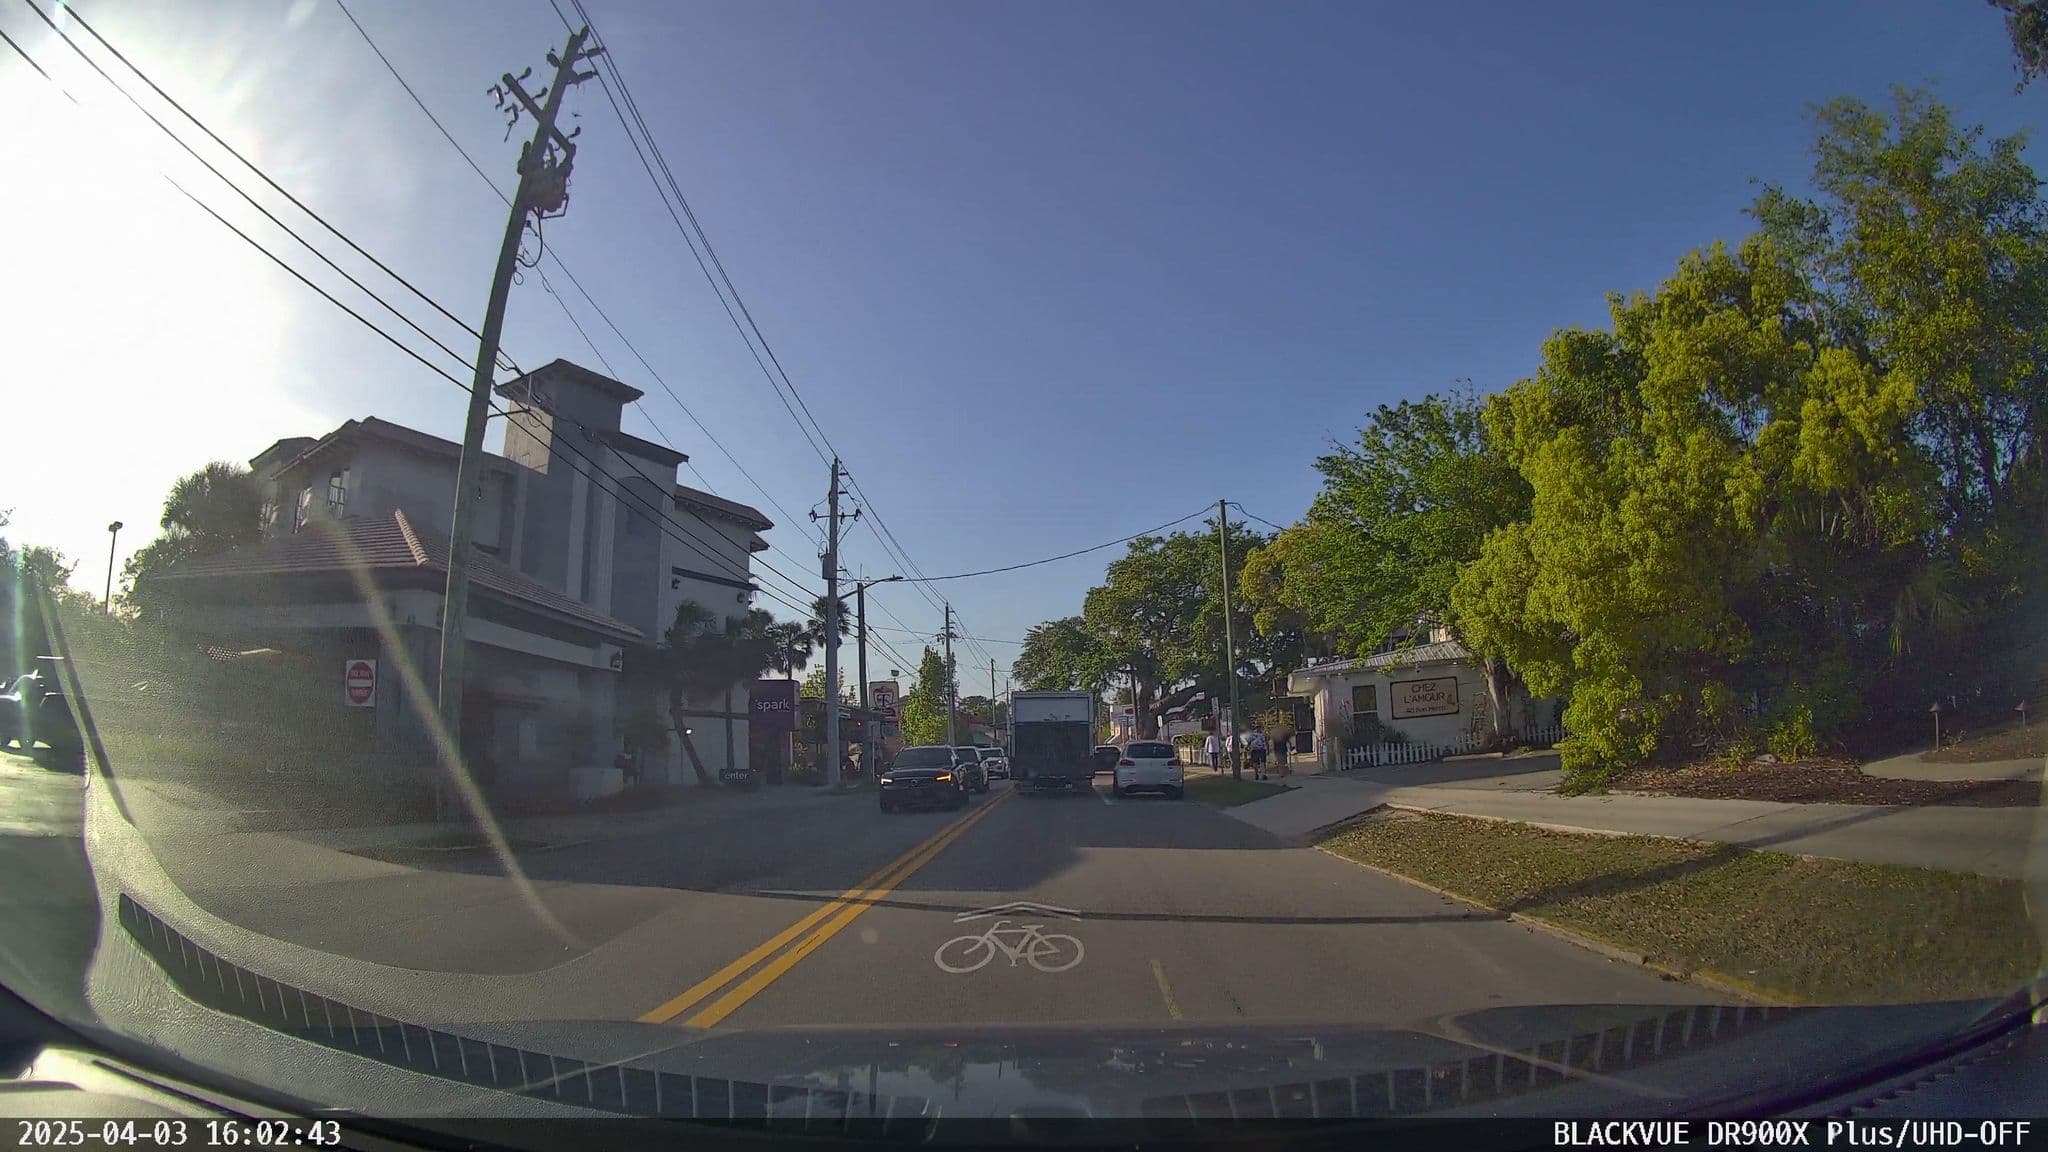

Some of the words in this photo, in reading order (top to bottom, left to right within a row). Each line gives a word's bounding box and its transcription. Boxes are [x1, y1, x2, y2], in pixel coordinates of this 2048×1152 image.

[1411, 682, 1436, 693] CHEZ
[1403, 692, 1445, 704] L'AMOUR
[756, 698, 790, 713] spark
[724, 771, 748, 781] enter
